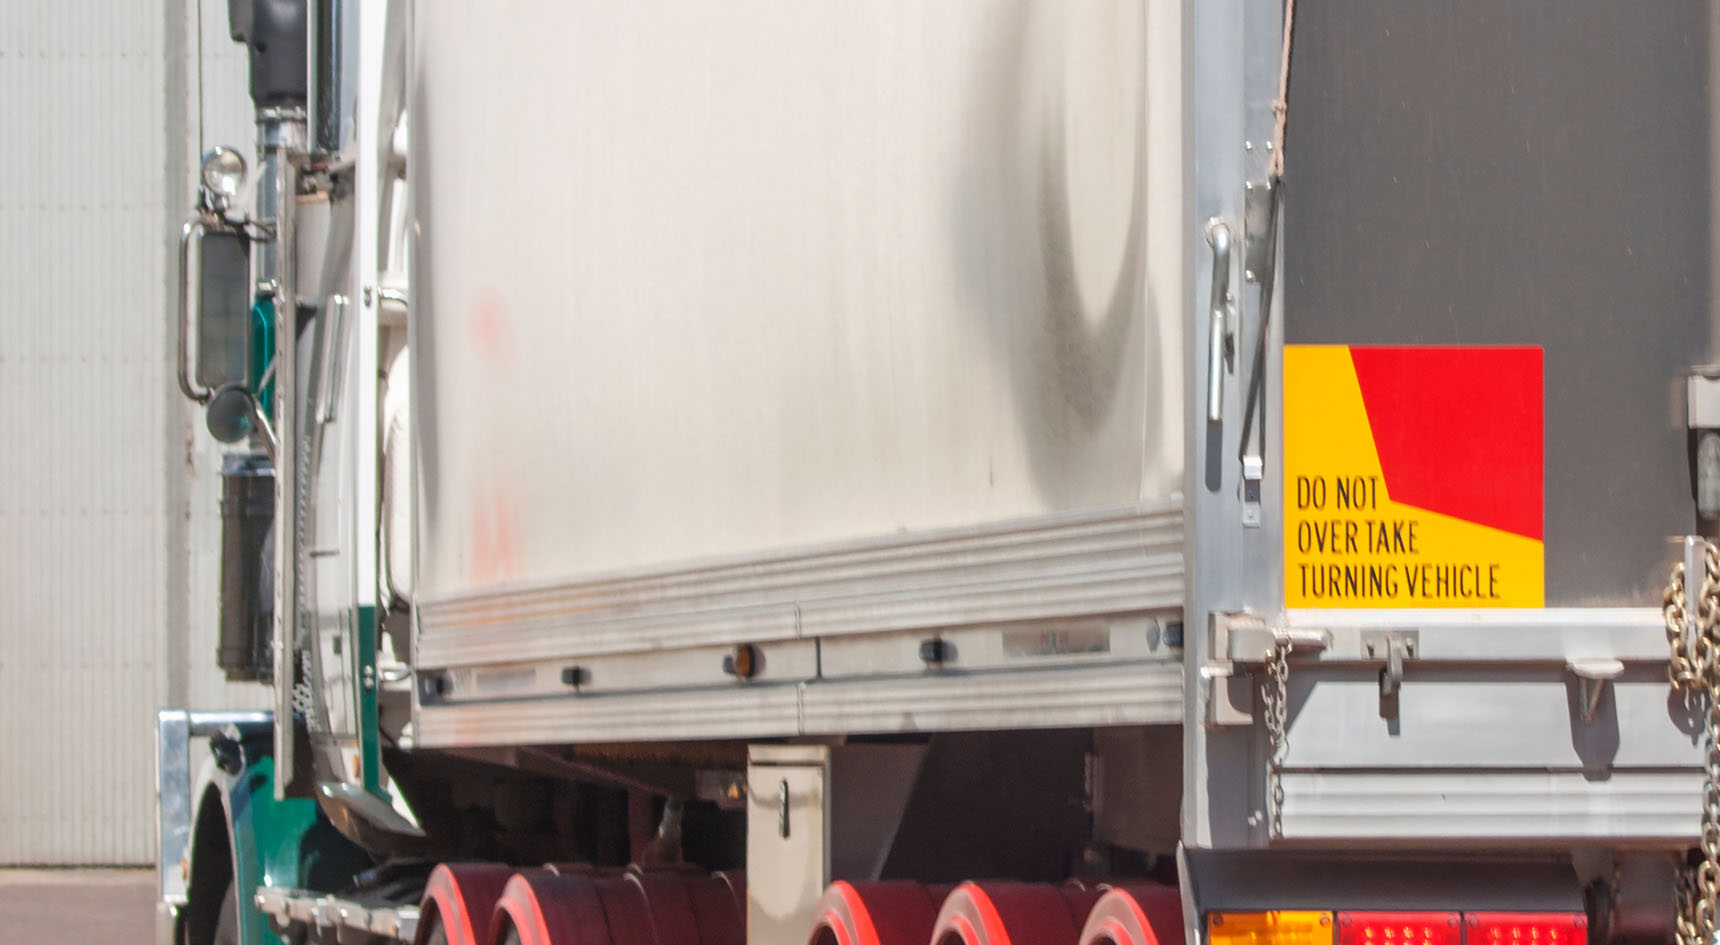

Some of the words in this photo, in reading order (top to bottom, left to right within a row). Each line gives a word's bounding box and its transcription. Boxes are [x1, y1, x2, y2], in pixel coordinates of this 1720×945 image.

[1296, 475, 1327, 511] DO
[1336, 475, 1379, 511] NOT
[1299, 563, 1398, 598] TURNING
[1404, 563, 1500, 598] VEHICLE
